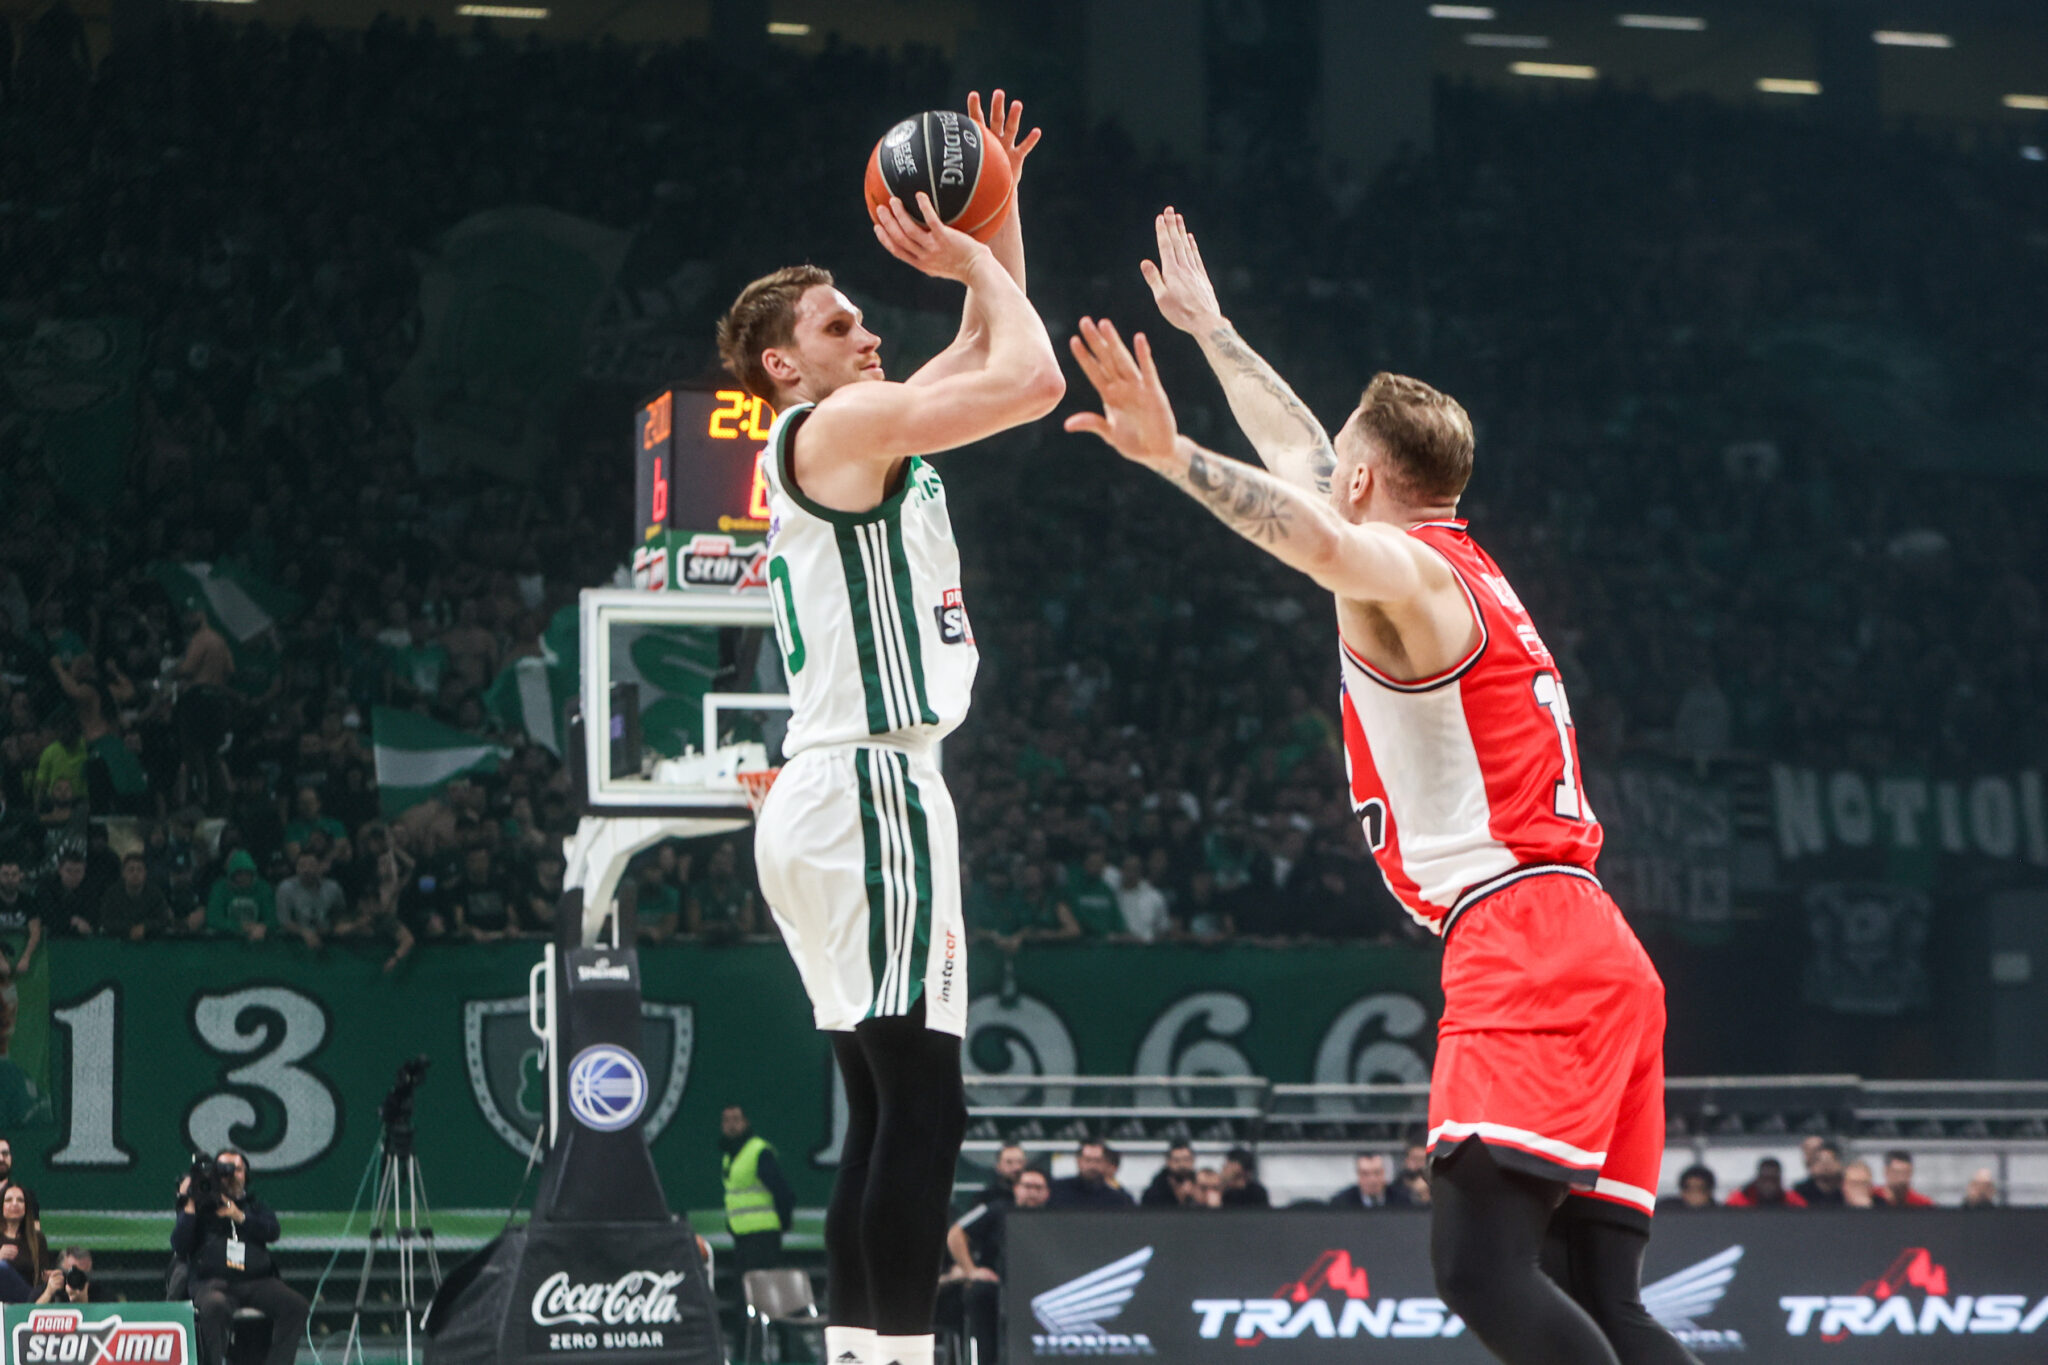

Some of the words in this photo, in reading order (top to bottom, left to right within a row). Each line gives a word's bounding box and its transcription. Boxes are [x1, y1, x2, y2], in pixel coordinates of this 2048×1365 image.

[937, 930, 956, 1002] instacar
[532, 1271, 685, 1326] Coca-Cola
[35, 1317, 73, 1332] pame
[550, 1332, 597, 1349] ZERO
[603, 1331, 663, 1348] SUGAR
